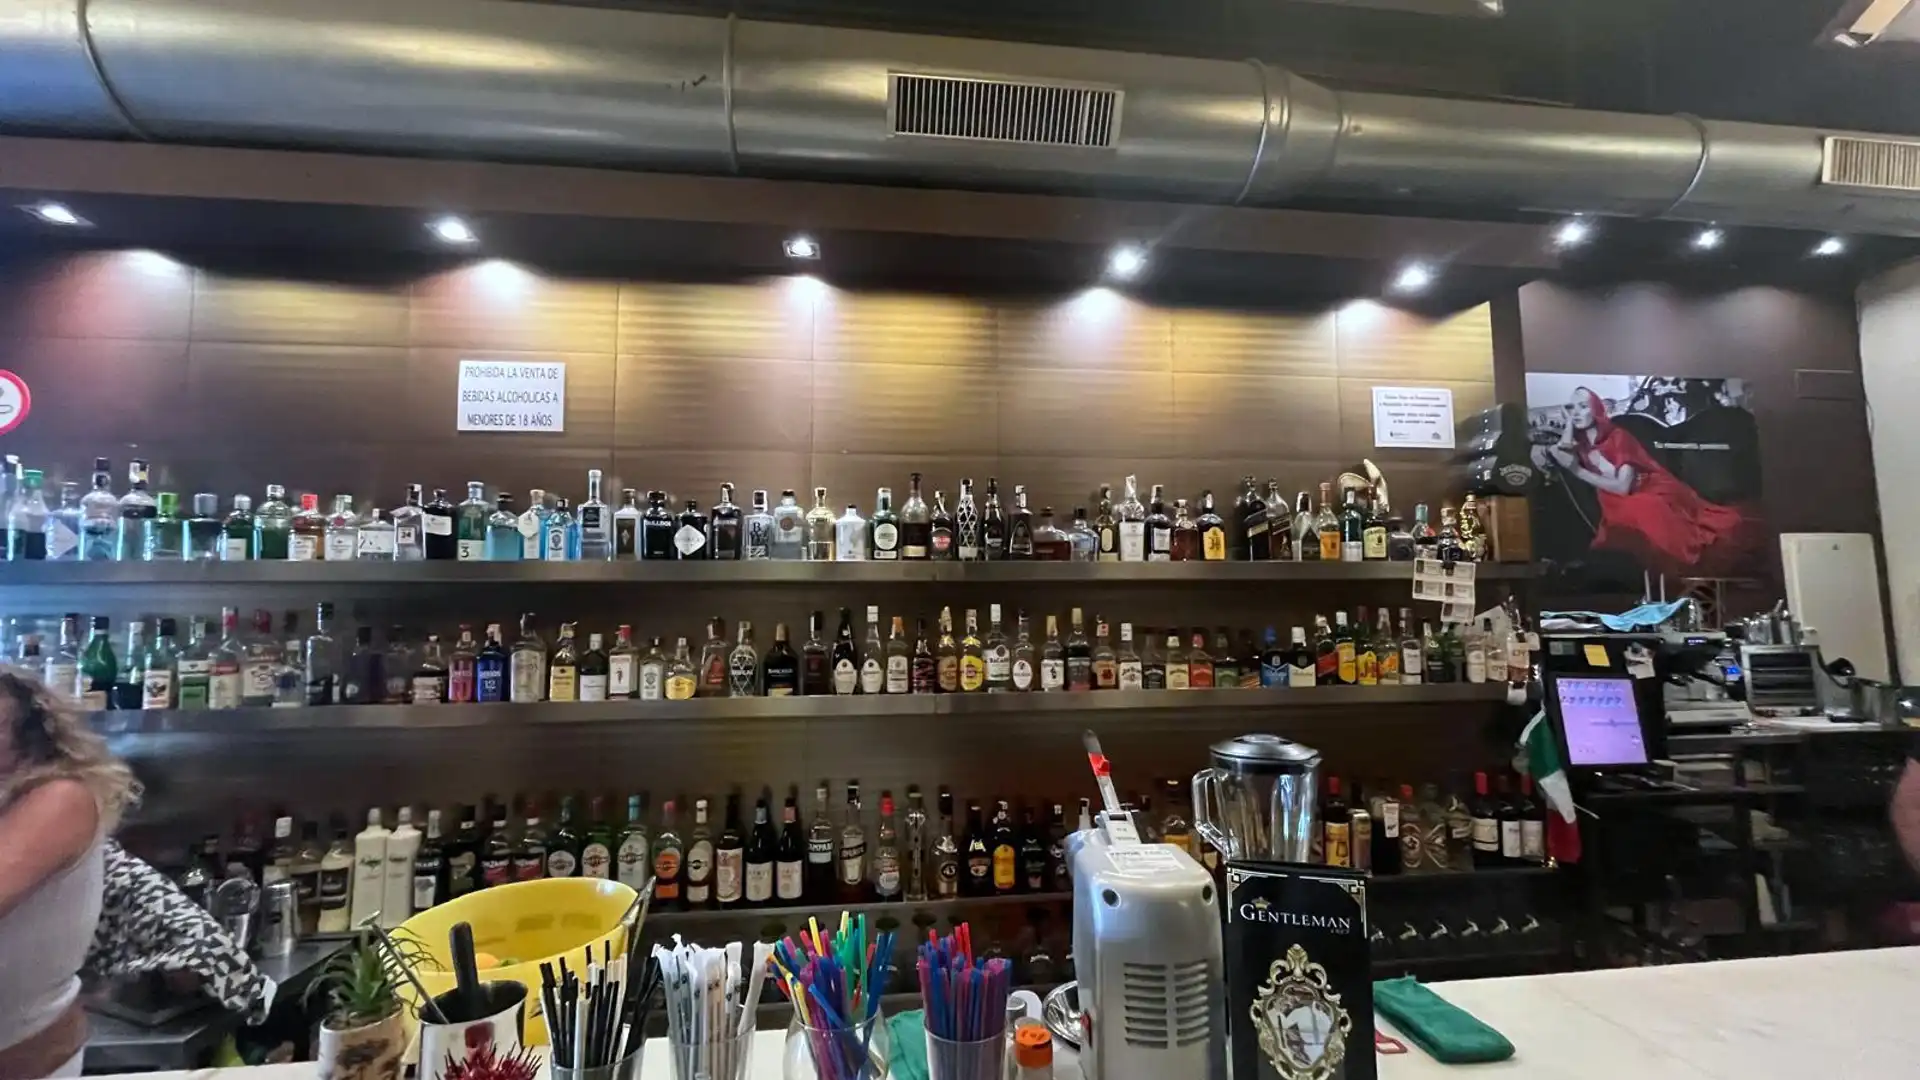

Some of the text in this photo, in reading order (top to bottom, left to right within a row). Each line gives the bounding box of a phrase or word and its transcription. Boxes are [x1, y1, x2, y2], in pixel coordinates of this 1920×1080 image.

[464, 366, 559, 380] PROHIBIDA LA VENTA DE
[462, 390, 495, 403] BEBIDAS
[552, 392, 559, 403] A
[467, 412, 553, 427] MENORES DE 18 AÑOS
[461, 546, 470, 558] 3
[1240, 903, 1351, 929] GENTLEMAN
